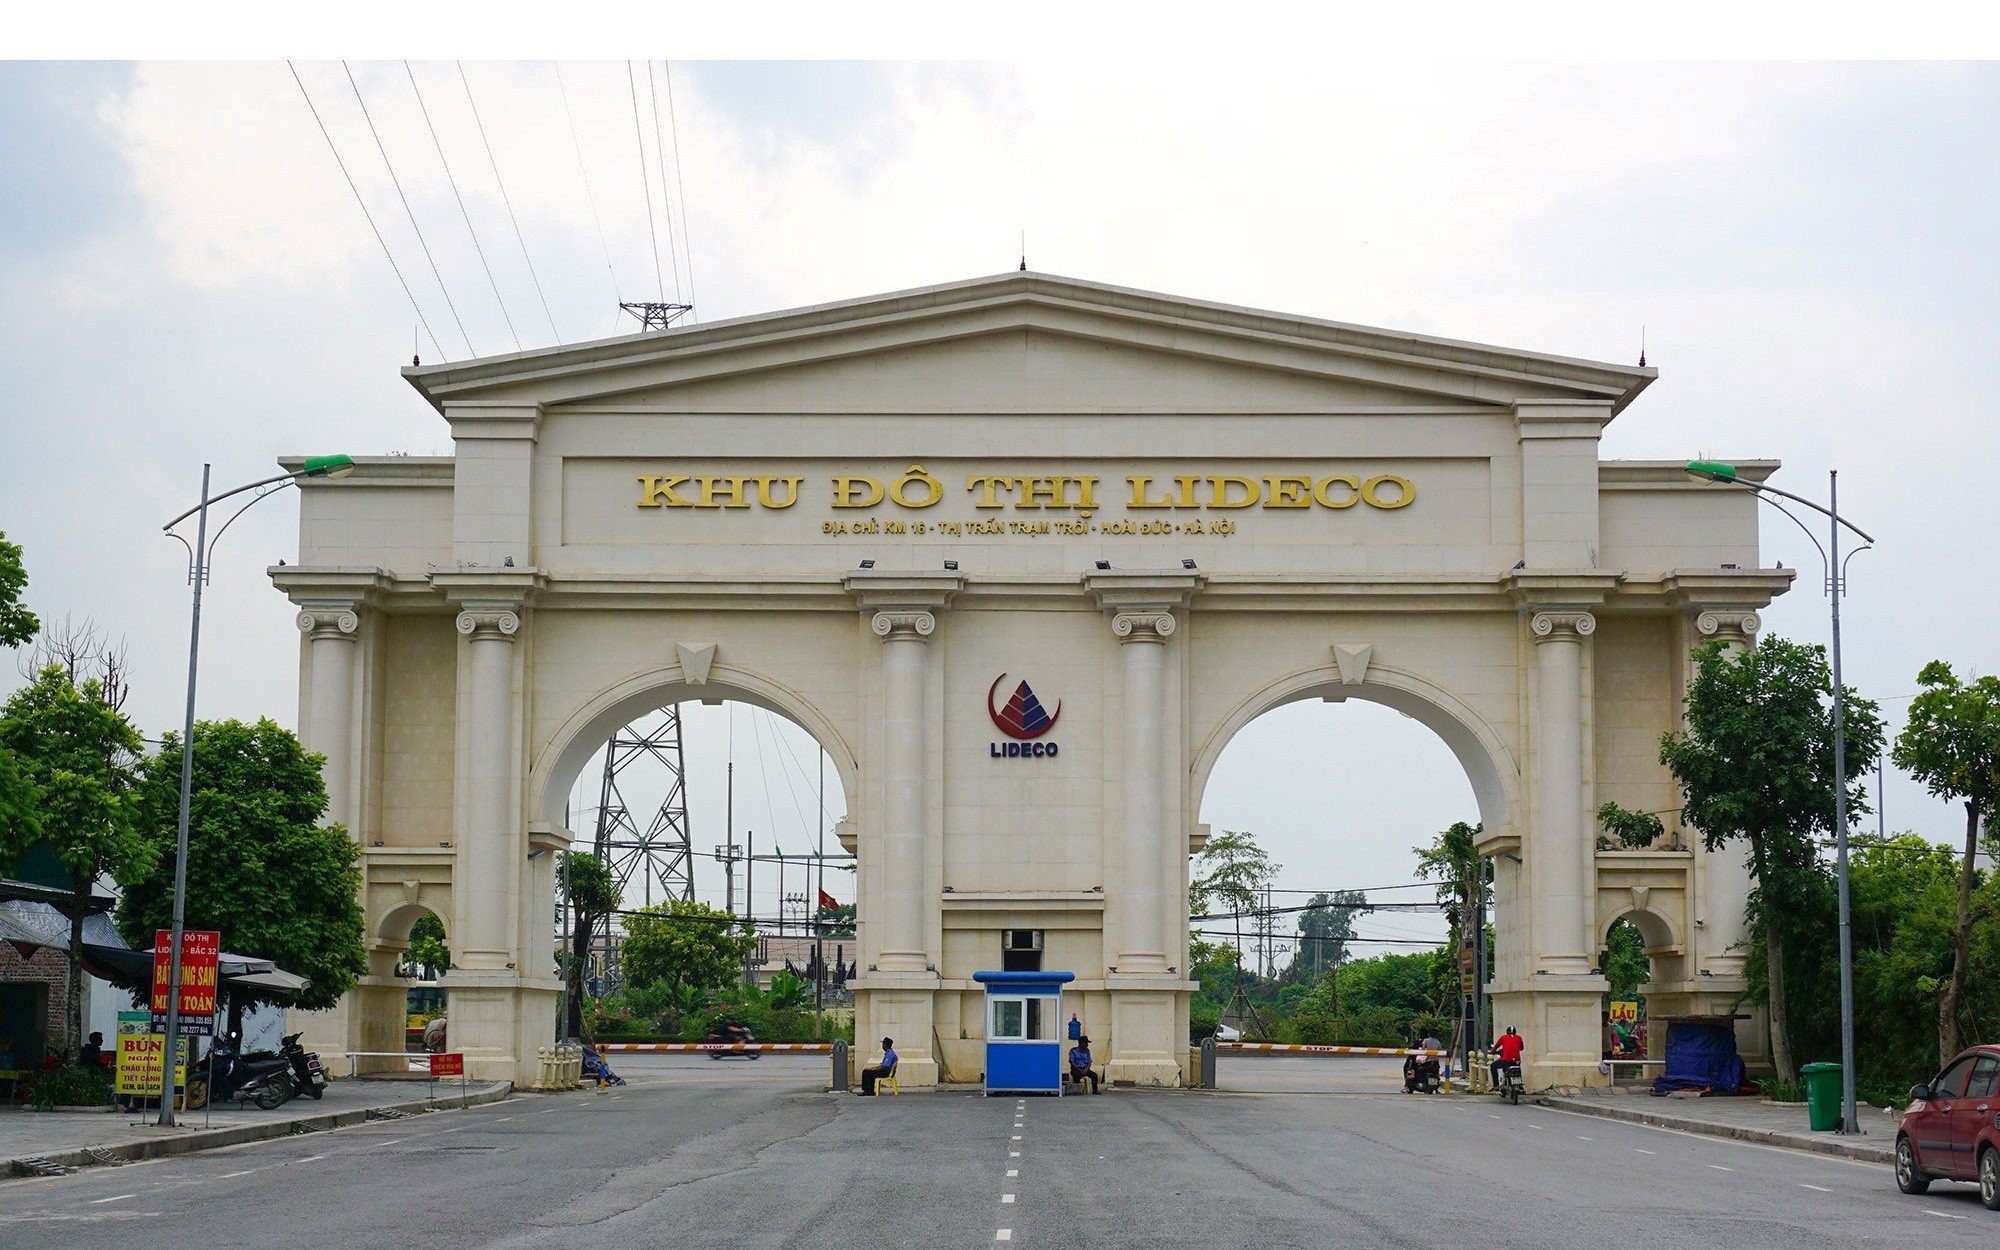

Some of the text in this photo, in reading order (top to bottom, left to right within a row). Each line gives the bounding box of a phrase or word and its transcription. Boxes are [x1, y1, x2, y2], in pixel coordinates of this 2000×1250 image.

[636, 464, 1416, 518] KHU ĐÔ THỊ LIDECO
[821, 521, 847, 537] ĐỊA
[883, 521, 907, 535] KM
[911, 521, 926, 535] 16
[938, 520, 961, 537] THỊ
[965, 517, 1006, 535] TRẤN
[1009, 520, 1050, 537] TRẠM
[1100, 519, 1137, 535] HOÀI
[1140, 519, 1172, 535] ĐỨC
[1184, 519, 1205, 535] HÀ
[1210, 519, 1237, 537] NỘI
[990, 742, 1059, 758] LIDECO
[197, 934, 210, 944] THỊ
[207, 947, 217, 955] 32
[197, 957, 215, 986] SẢN
[184, 992, 213, 1010] TOÀN
[123, 1037, 162, 1052] BÚN
